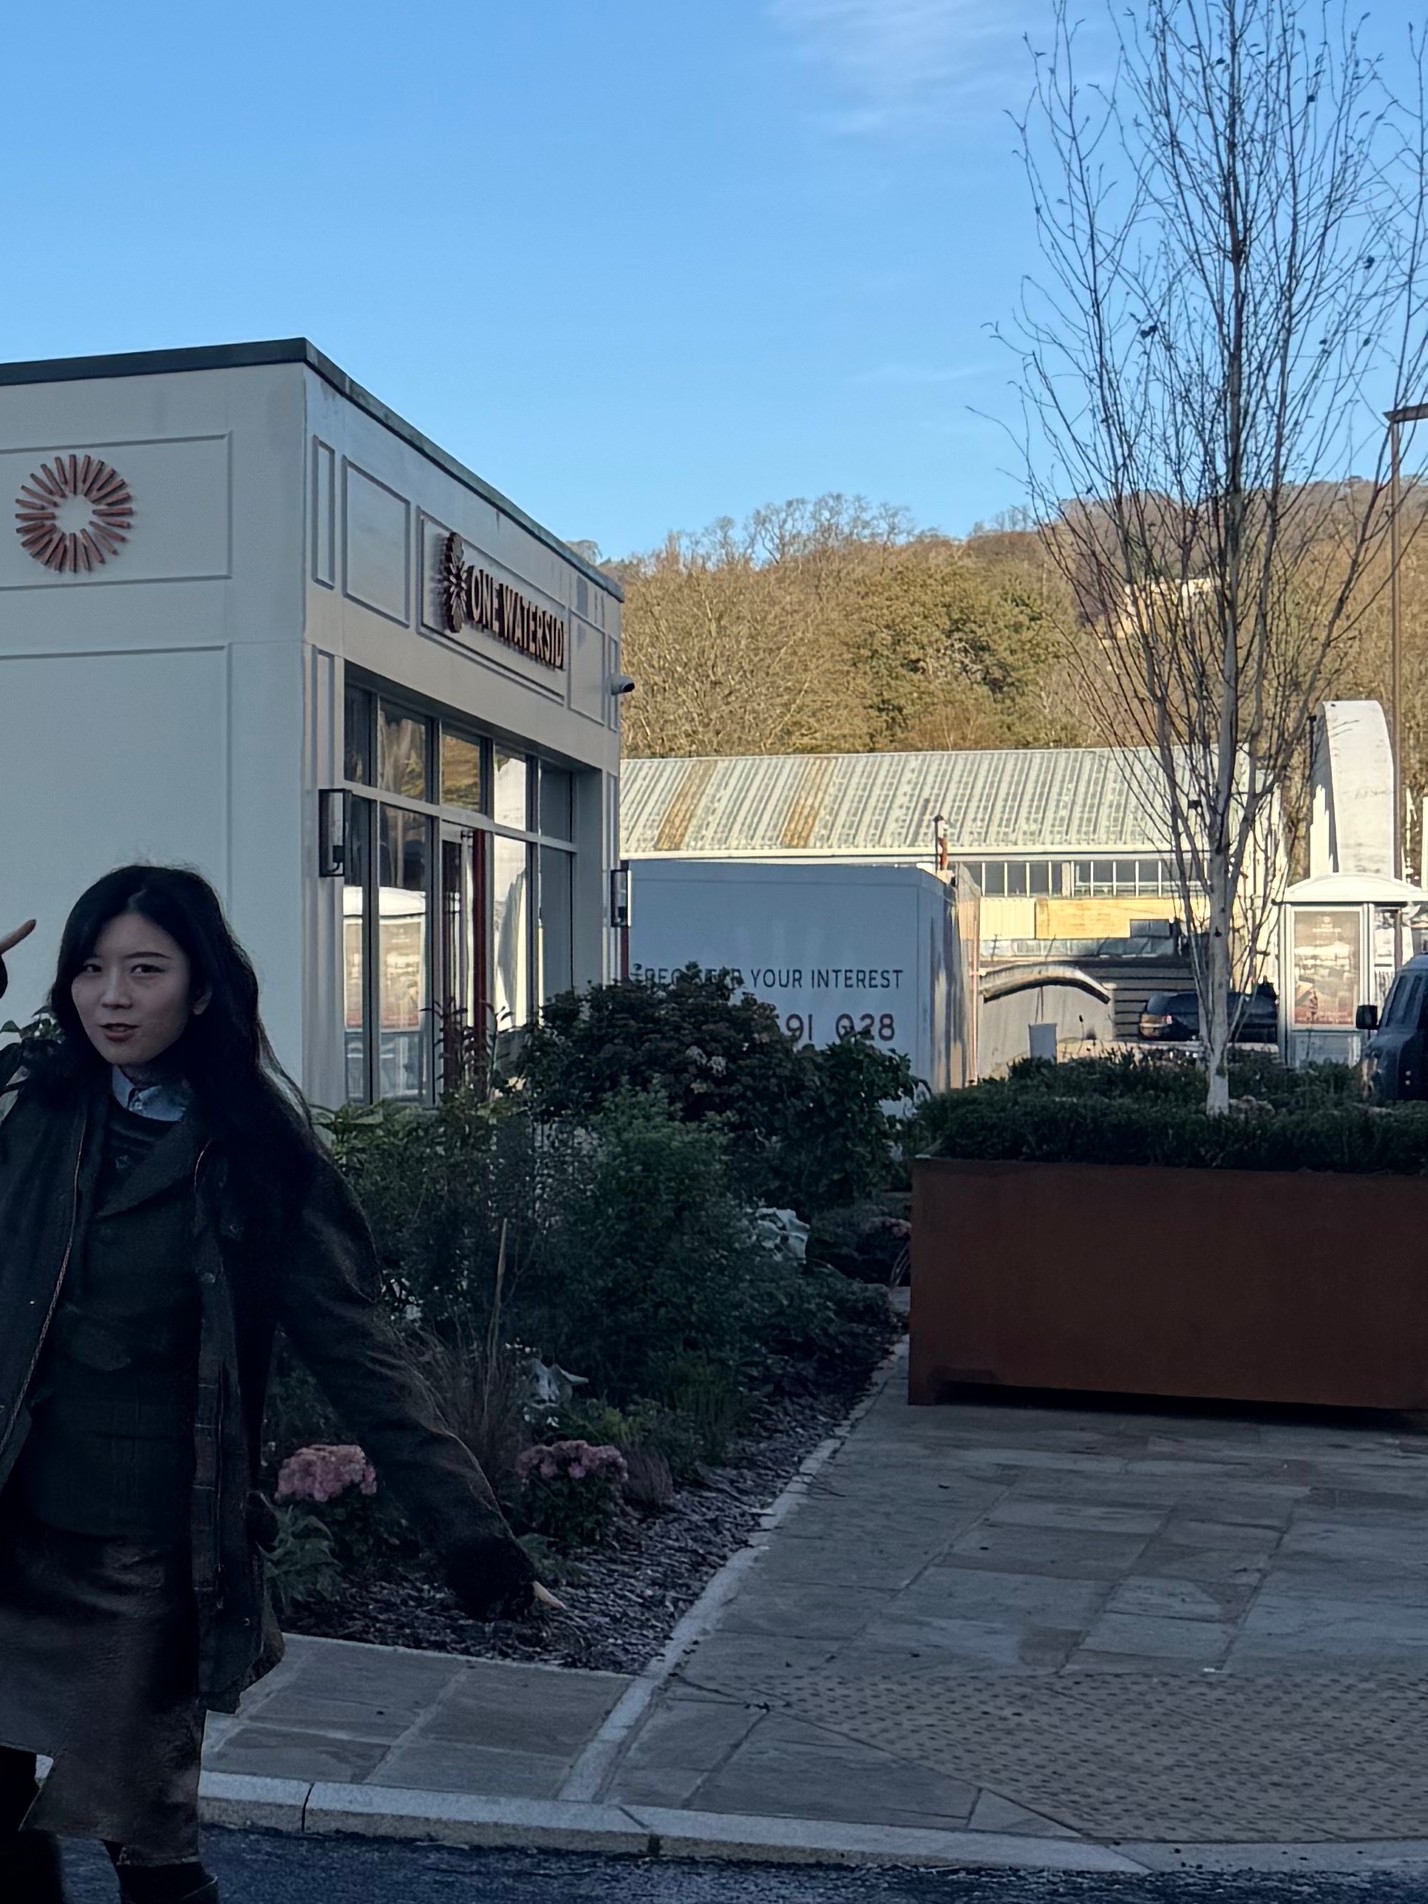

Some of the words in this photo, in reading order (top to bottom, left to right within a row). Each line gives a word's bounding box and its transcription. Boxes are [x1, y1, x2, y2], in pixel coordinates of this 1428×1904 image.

[467, 565, 500, 633] ONE
[750, 968, 802, 988] YOUR
[811, 969, 903, 989] INTEREST
[775, 1013, 812, 1041] 91
